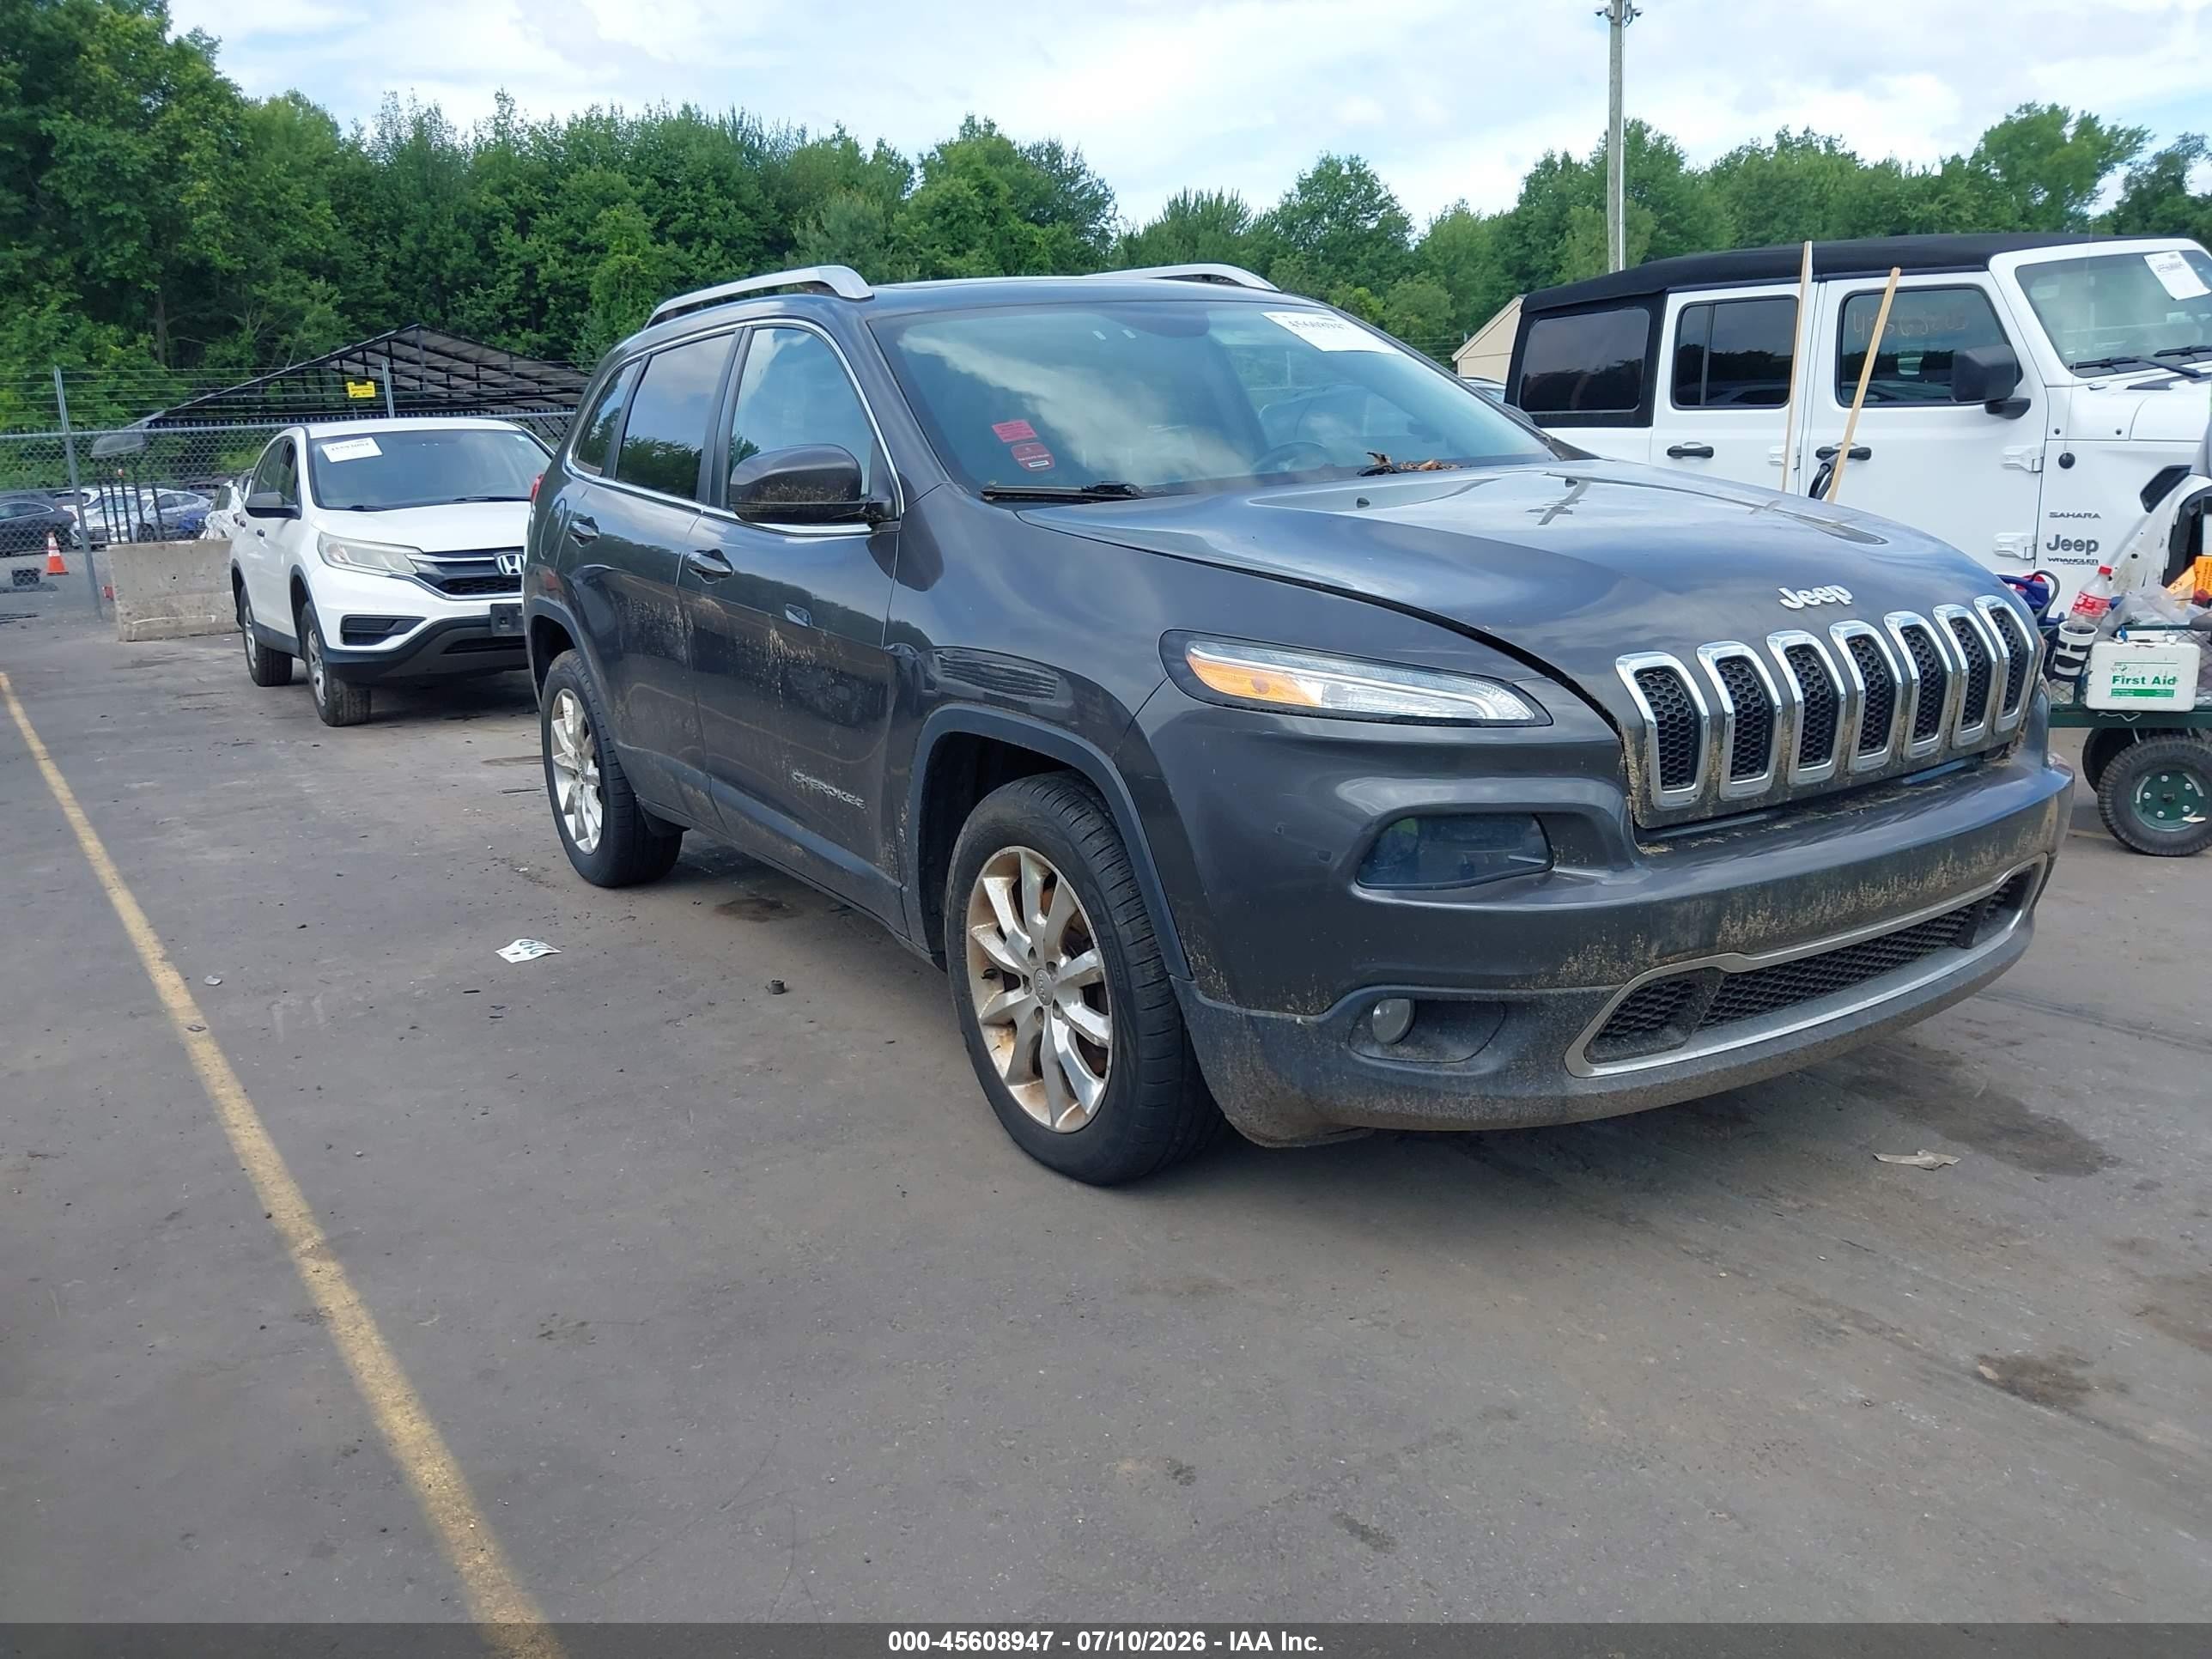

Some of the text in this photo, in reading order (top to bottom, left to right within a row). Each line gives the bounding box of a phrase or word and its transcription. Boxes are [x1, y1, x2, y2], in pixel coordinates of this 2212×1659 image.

[2046, 534, 2099, 556] Jeep
[1778, 585, 1853, 610] Jeep
[2112, 675, 2177, 685] First Aid
